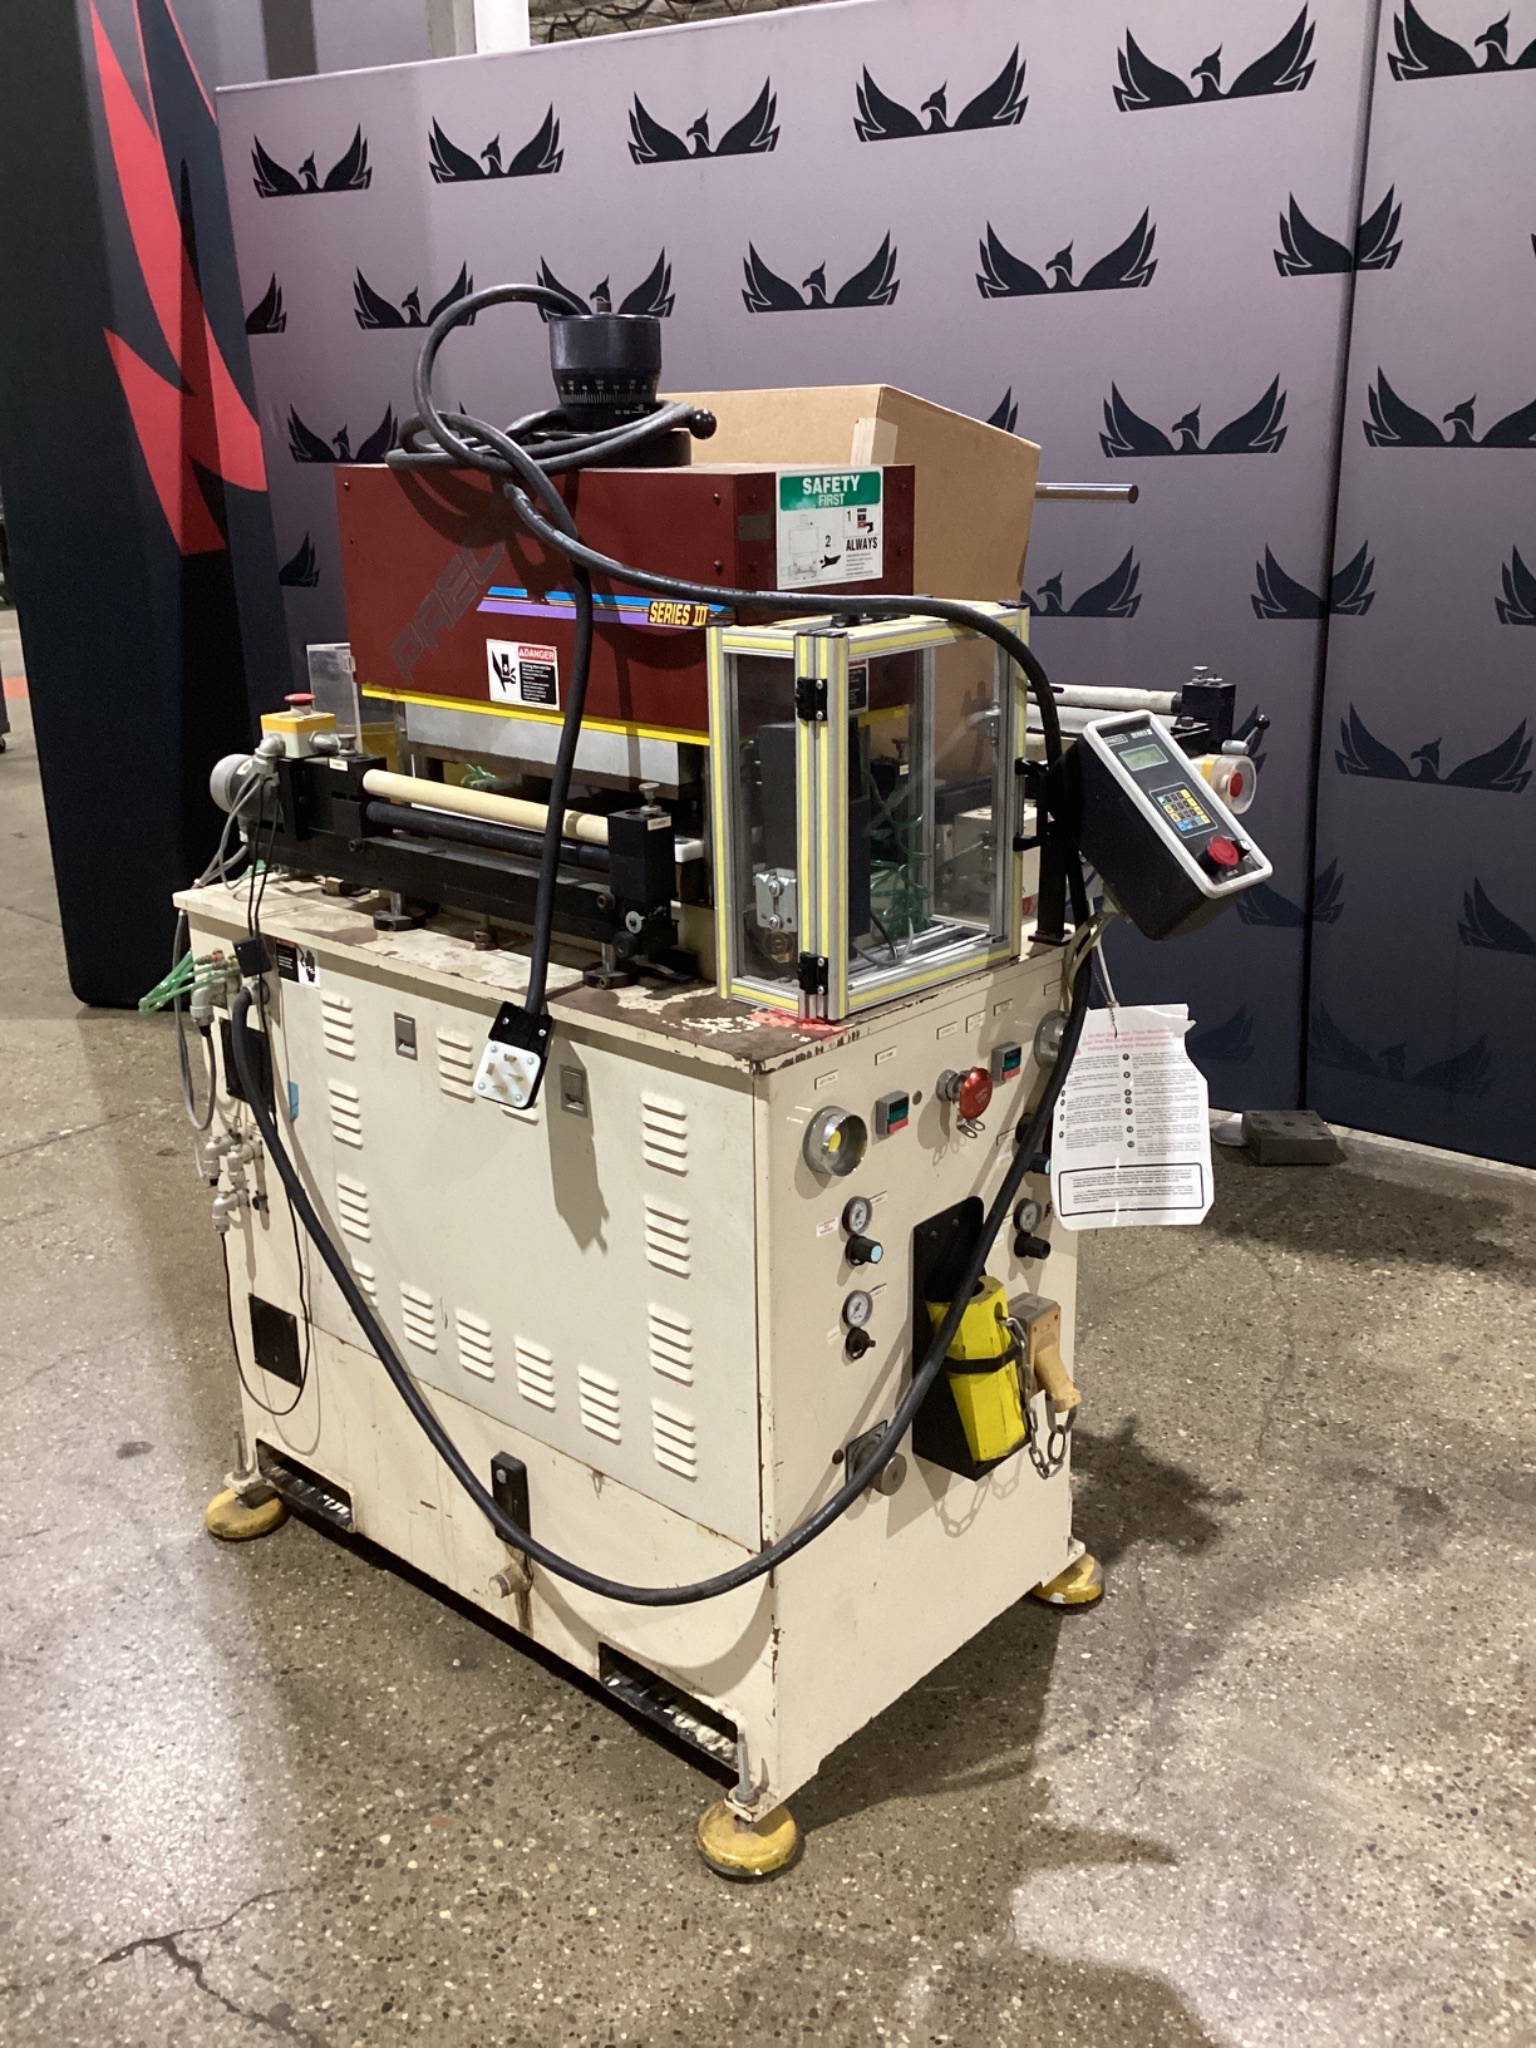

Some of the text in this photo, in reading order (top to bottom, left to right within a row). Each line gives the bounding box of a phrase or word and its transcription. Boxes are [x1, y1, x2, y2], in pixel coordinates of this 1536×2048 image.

[802, 474, 860, 495] SAFETY
[818, 493, 846, 507] FIRST
[847, 510, 851, 522] 1
[825, 535, 832, 548] 2
[846, 536, 878, 551] ALWAYS
[649, 601, 691, 626] SERIES
[524, 648, 554, 661] DANGER
